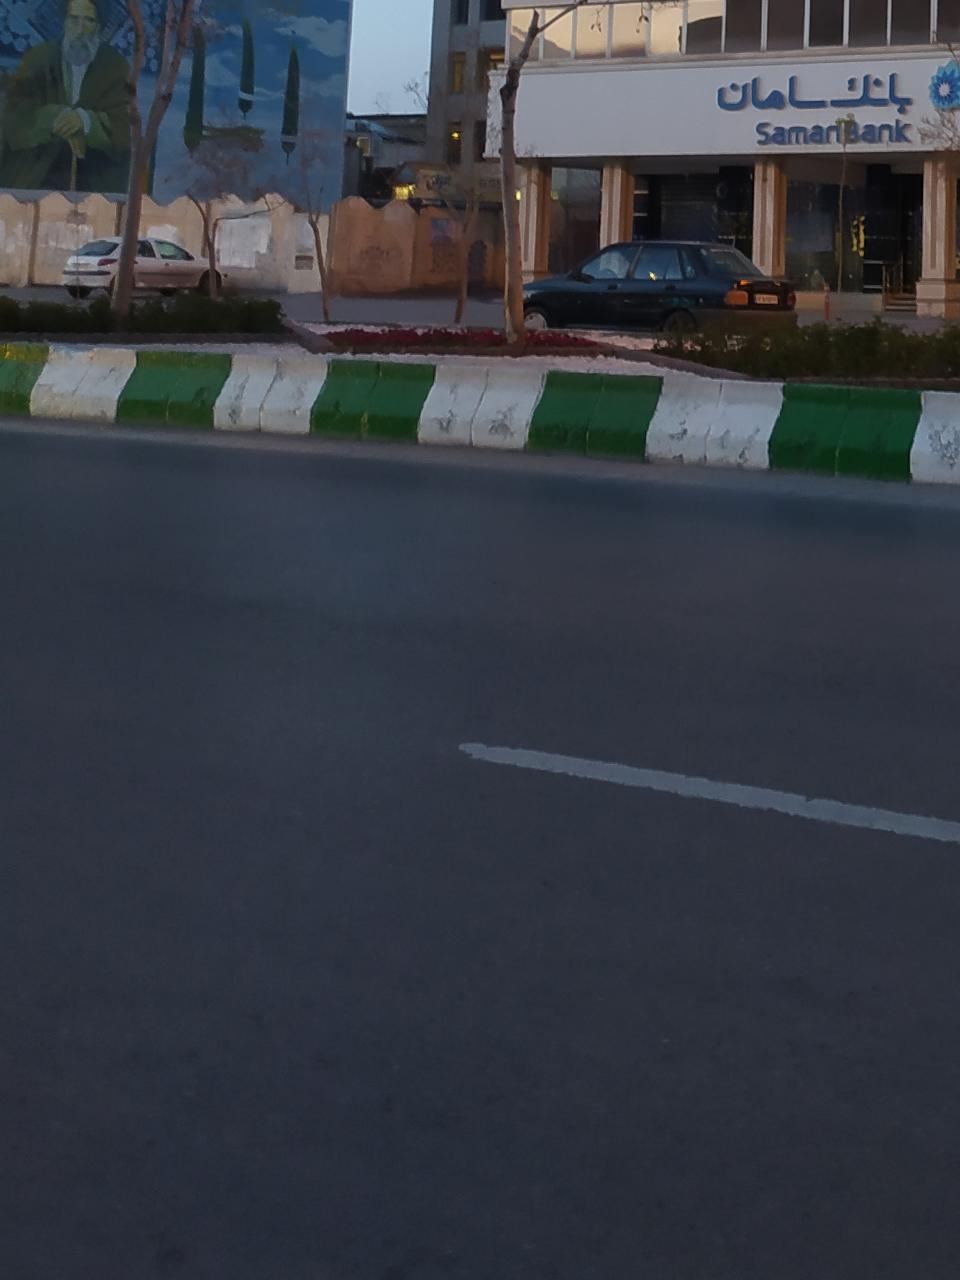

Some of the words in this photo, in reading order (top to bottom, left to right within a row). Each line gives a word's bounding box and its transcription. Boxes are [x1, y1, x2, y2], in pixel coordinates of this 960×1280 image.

[717, 75, 827, 111] سامان
[830, 73, 913, 114] بانک
[756, 122, 841, 146] Saman
[844, 119, 912, 144] Bank
